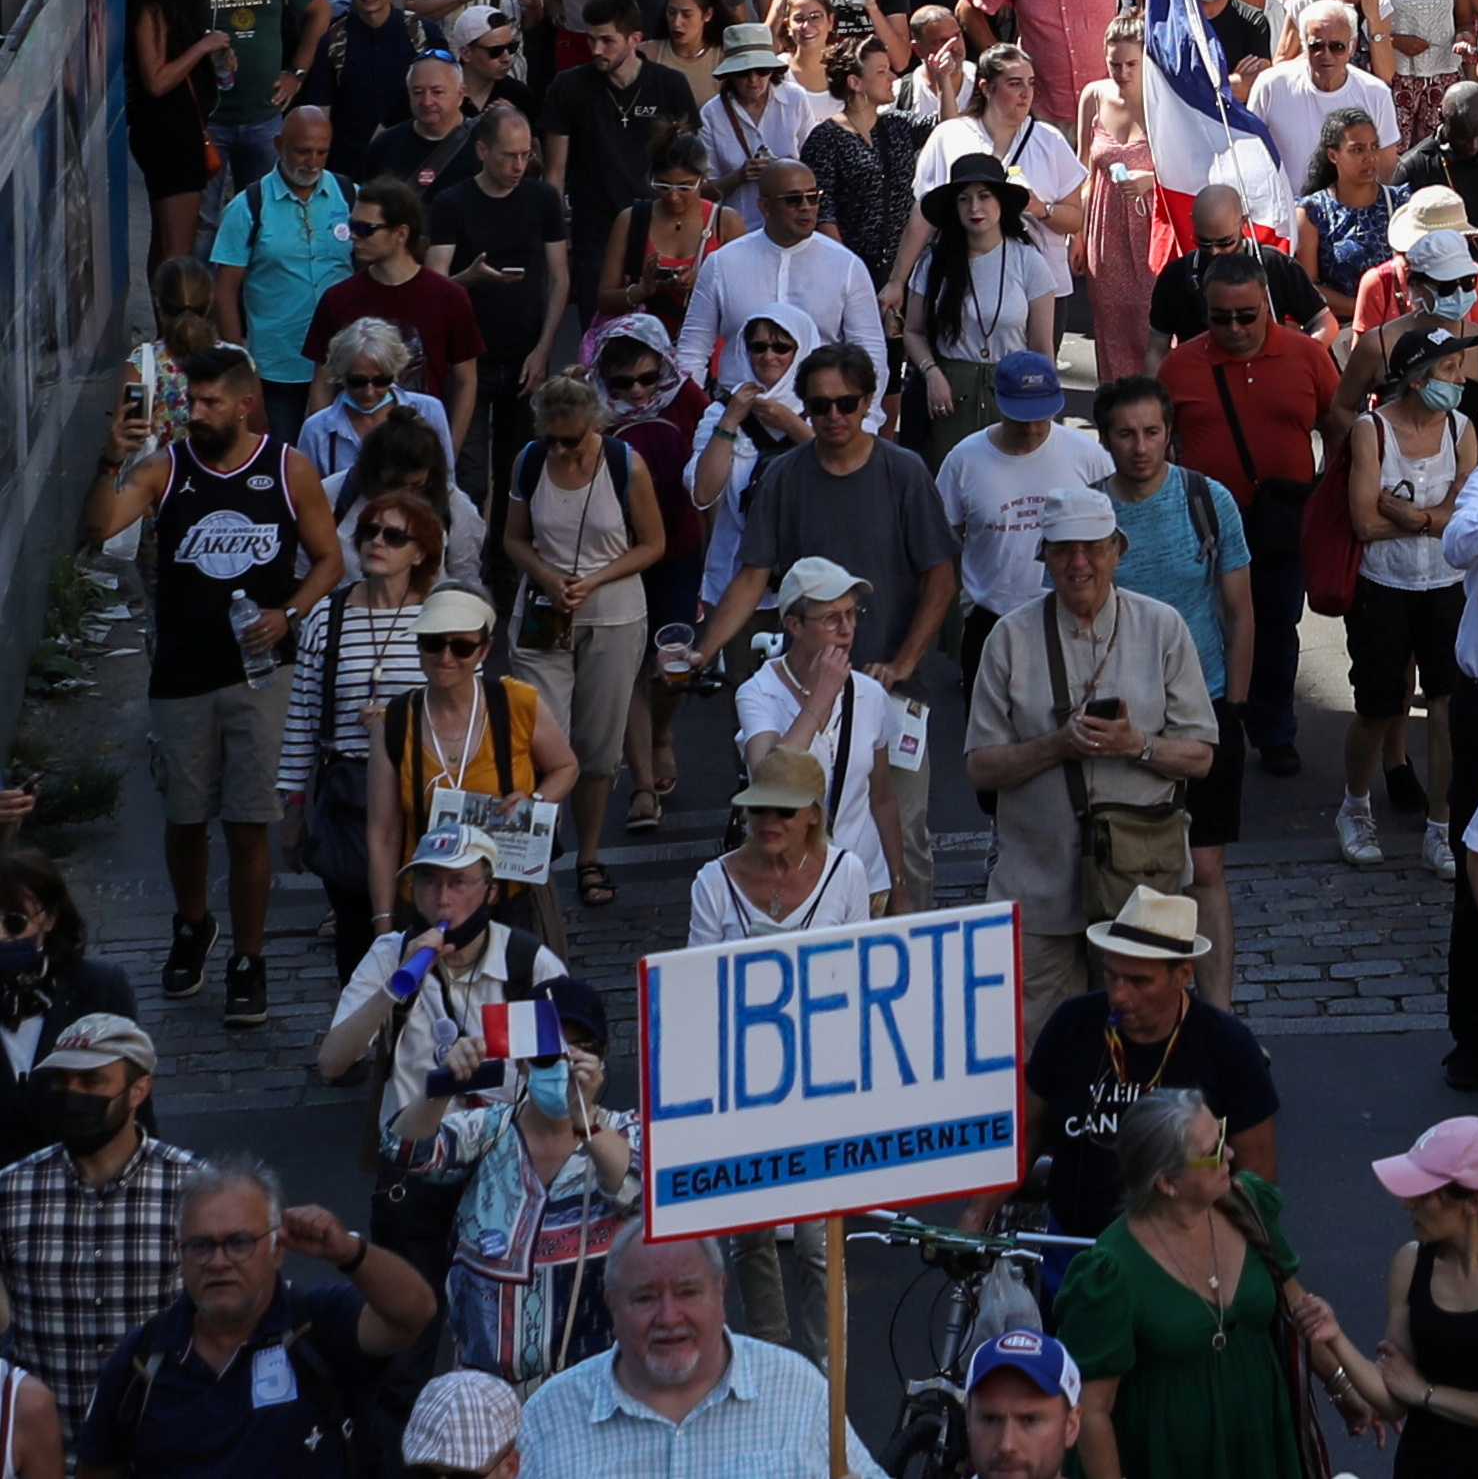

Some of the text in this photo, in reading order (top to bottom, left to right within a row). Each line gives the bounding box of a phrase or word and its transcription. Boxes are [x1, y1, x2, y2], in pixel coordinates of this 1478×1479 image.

[1027, 496, 1045, 504] TIEN
[182, 528, 273, 561] LAKERS
[210, 526, 275, 535] LOS ANGELES
[648, 912, 1016, 1122] LIBERTE
[673, 1116, 1011, 1198] EGALITE FRATERNITE
